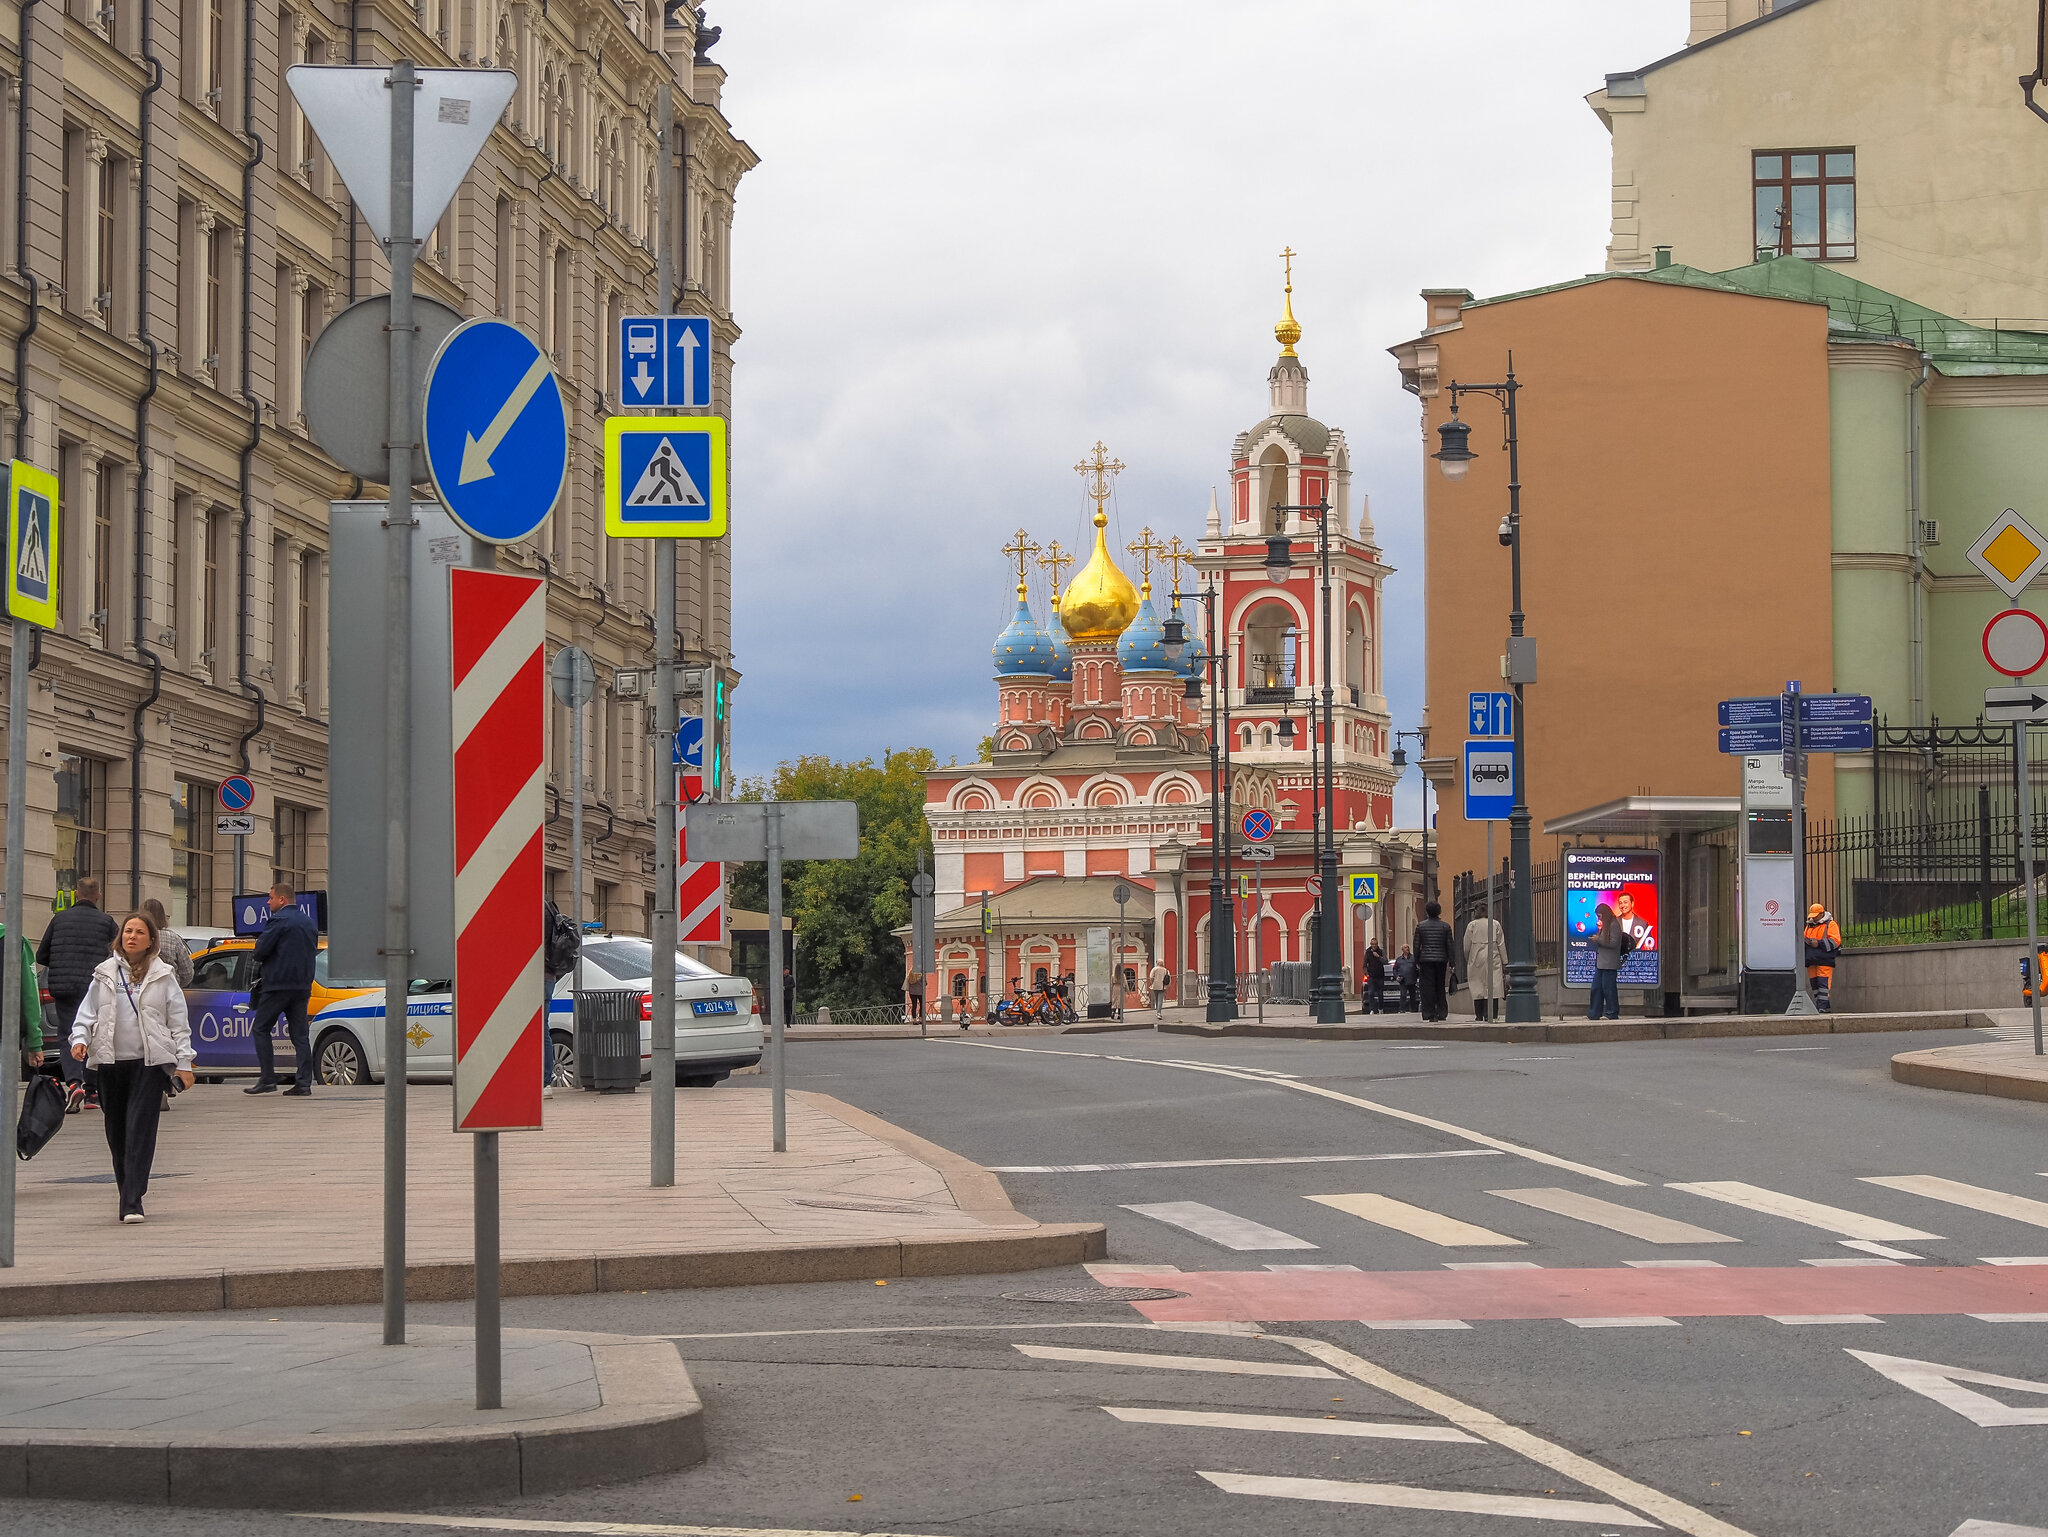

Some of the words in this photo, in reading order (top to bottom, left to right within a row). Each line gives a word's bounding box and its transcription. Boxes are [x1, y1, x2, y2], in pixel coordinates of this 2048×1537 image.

[1568, 872, 1603, 880] ВЕРНЁМ
[1605, 873, 1653, 881] ПРОЦЕНТЫ
[1582, 882, 1622, 890] КРЕДИТУ
[407, 1005, 439, 1015] ЛИЦИЯ
[704, 1002, 724, 1012] 2074
[222, 1017, 279, 1037] алиа
